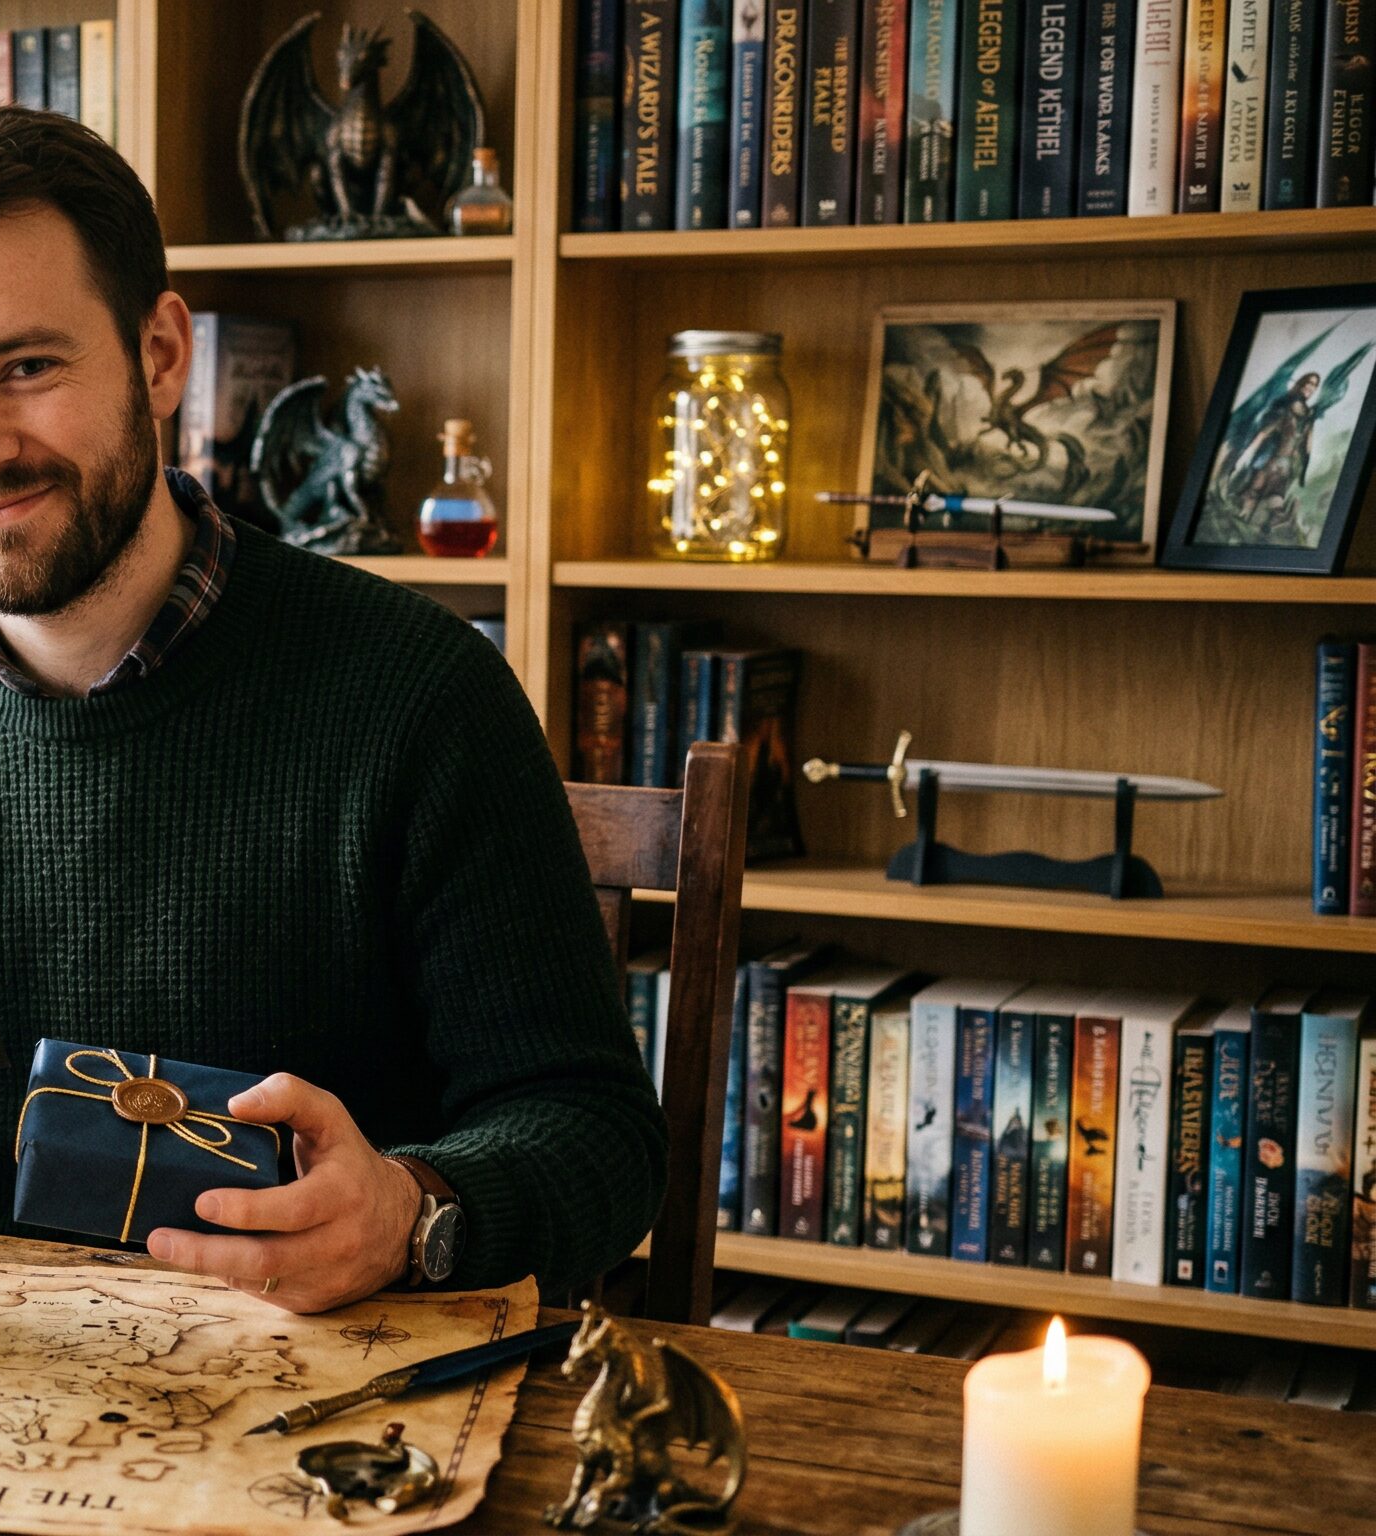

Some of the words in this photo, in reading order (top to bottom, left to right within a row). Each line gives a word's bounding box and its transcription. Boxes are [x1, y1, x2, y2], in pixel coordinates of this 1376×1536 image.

[640, 11, 662, 29] A
[977, 0, 1003, 74] LEGEND
[1039, 3, 1066, 81] LEGEND
[636, 31, 662, 140] WIZARD'S
[771, 8, 797, 176] DRAGONRIDERS
[635, 142, 658, 197] TALE
[973, 99, 1000, 171] AETHEL
[32, 1486, 125, 1511] THE
